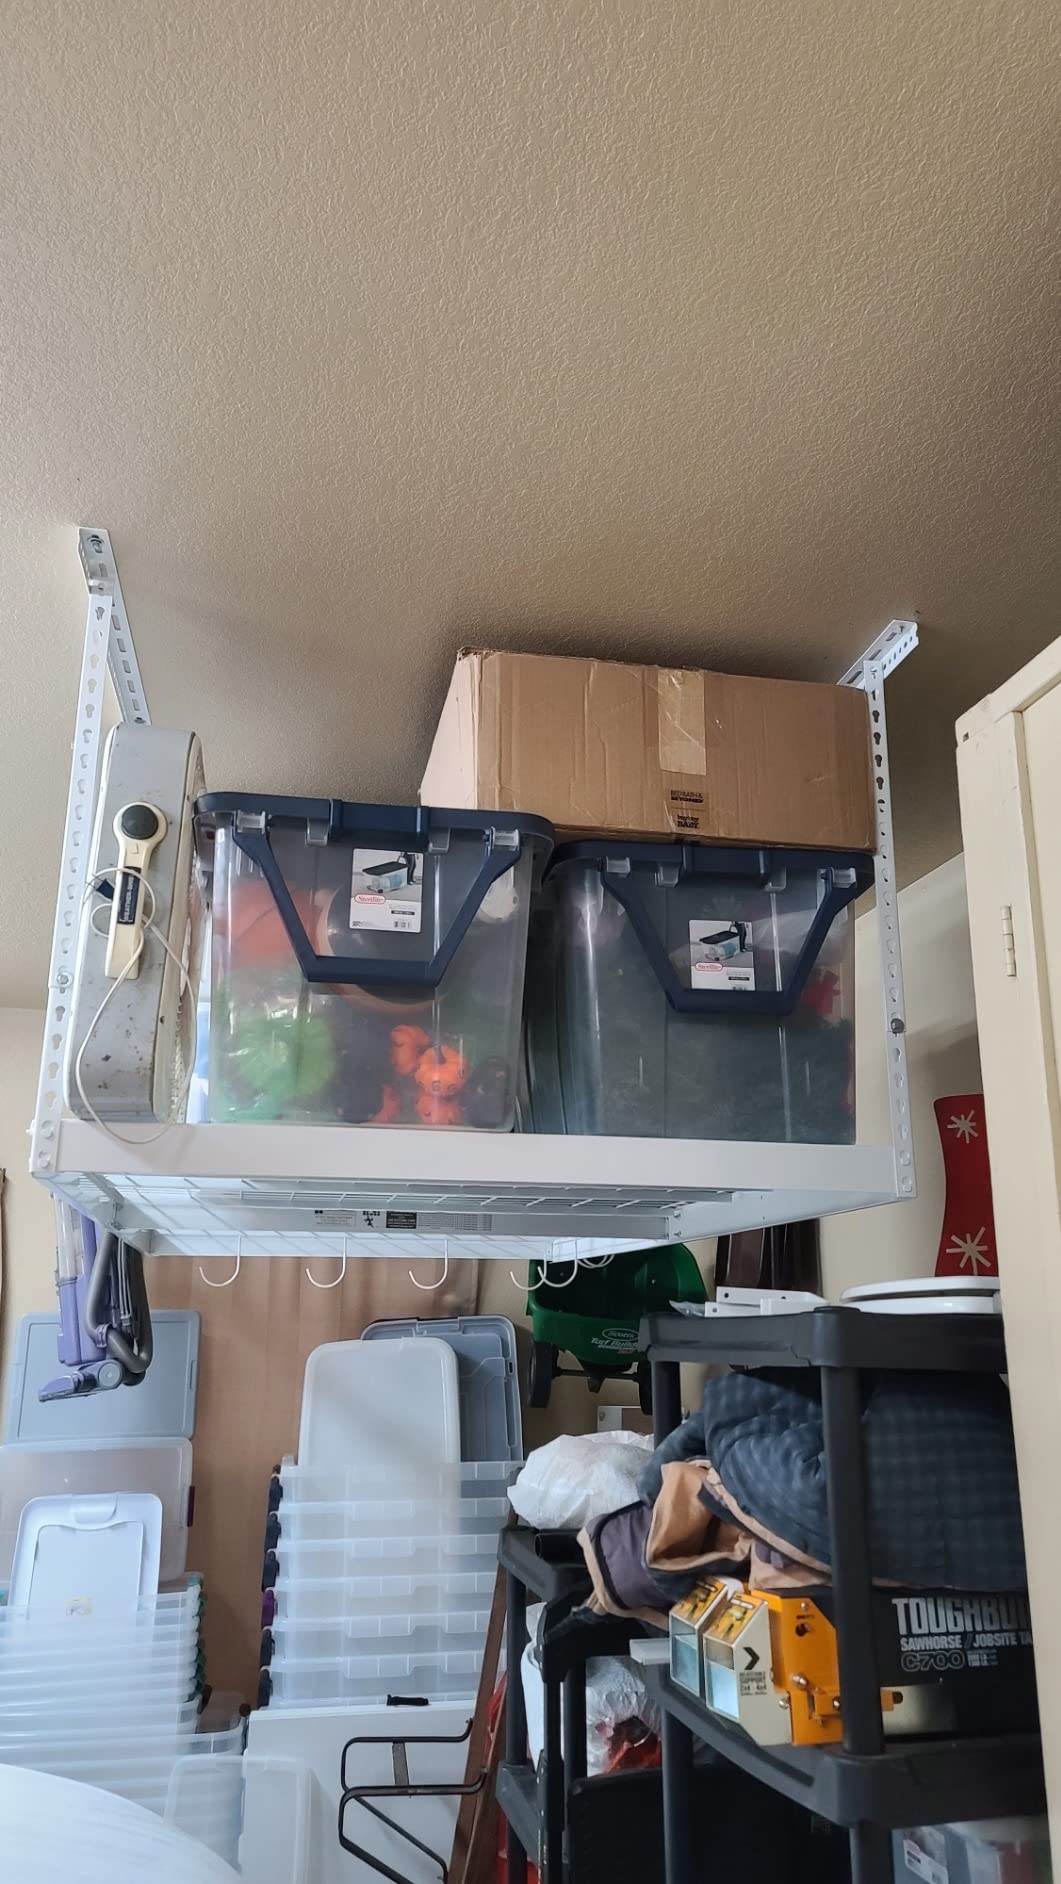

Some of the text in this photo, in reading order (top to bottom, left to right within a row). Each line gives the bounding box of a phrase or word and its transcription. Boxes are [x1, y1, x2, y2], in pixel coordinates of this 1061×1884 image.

[591, 1337, 610, 1345] Turf
[900, 1634, 962, 1651] SAWHORSE
[973, 1632, 1017, 1647] JOBSITE
[901, 1649, 965, 1671] C700
